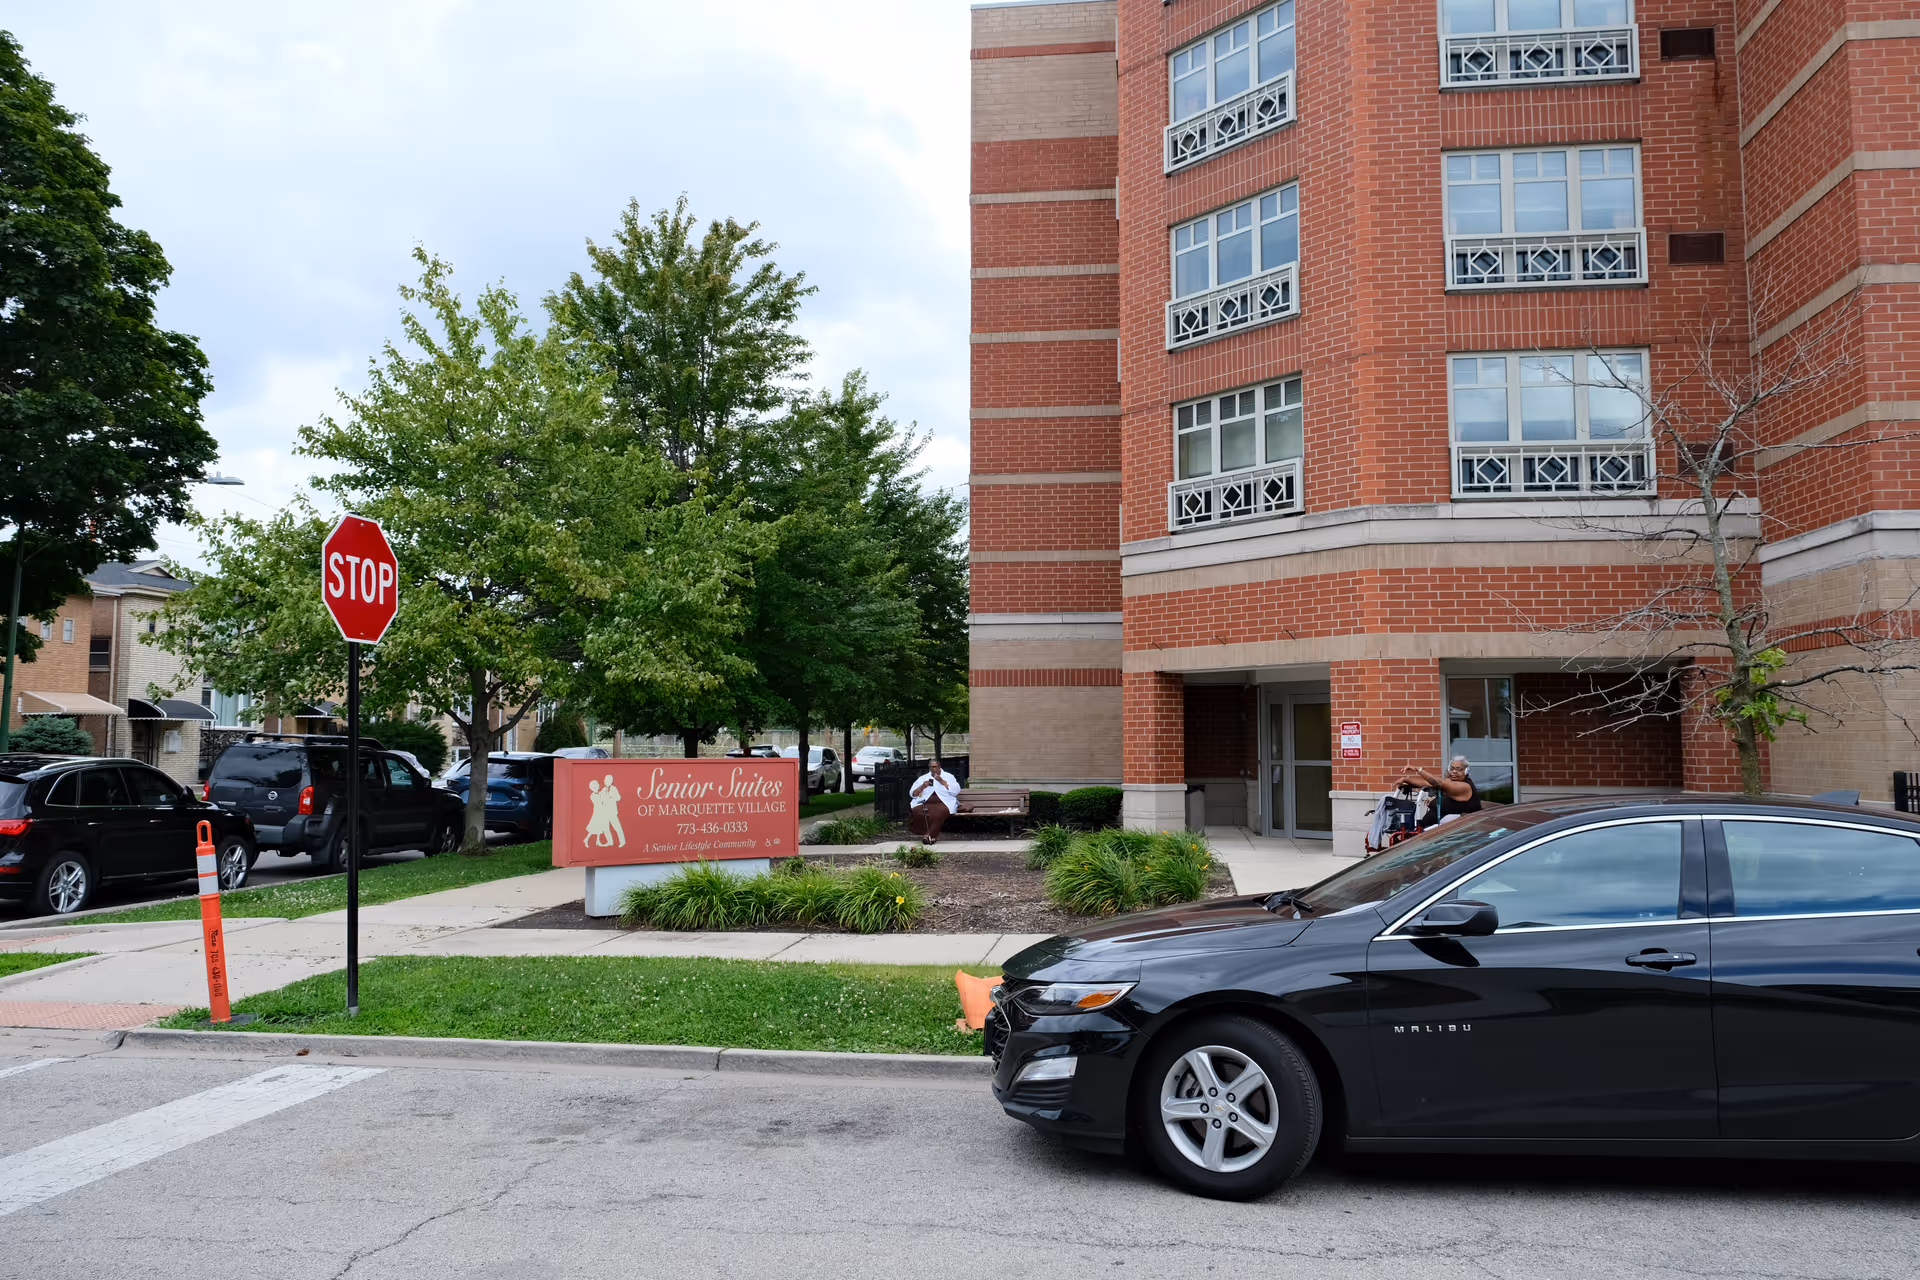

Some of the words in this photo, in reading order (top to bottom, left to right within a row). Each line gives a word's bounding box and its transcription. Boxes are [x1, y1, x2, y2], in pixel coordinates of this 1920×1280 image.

[328, 552, 393, 604] STOP
[636, 767, 715, 800] Senior
[718, 766, 784, 798] Suites
[637, 806, 655, 817] OF
[658, 803, 735, 817] MARQUETTE
[737, 801, 786, 814] VILLAGE
[676, 821, 748, 835] 773-436-0333
[642, 844, 650, 853] A
[651, 842, 678, 853] Senior
[679, 839, 712, 851] Lifestyle
[713, 838, 757, 850] Community
[1394, 1024, 1471, 1033] MALIBU
